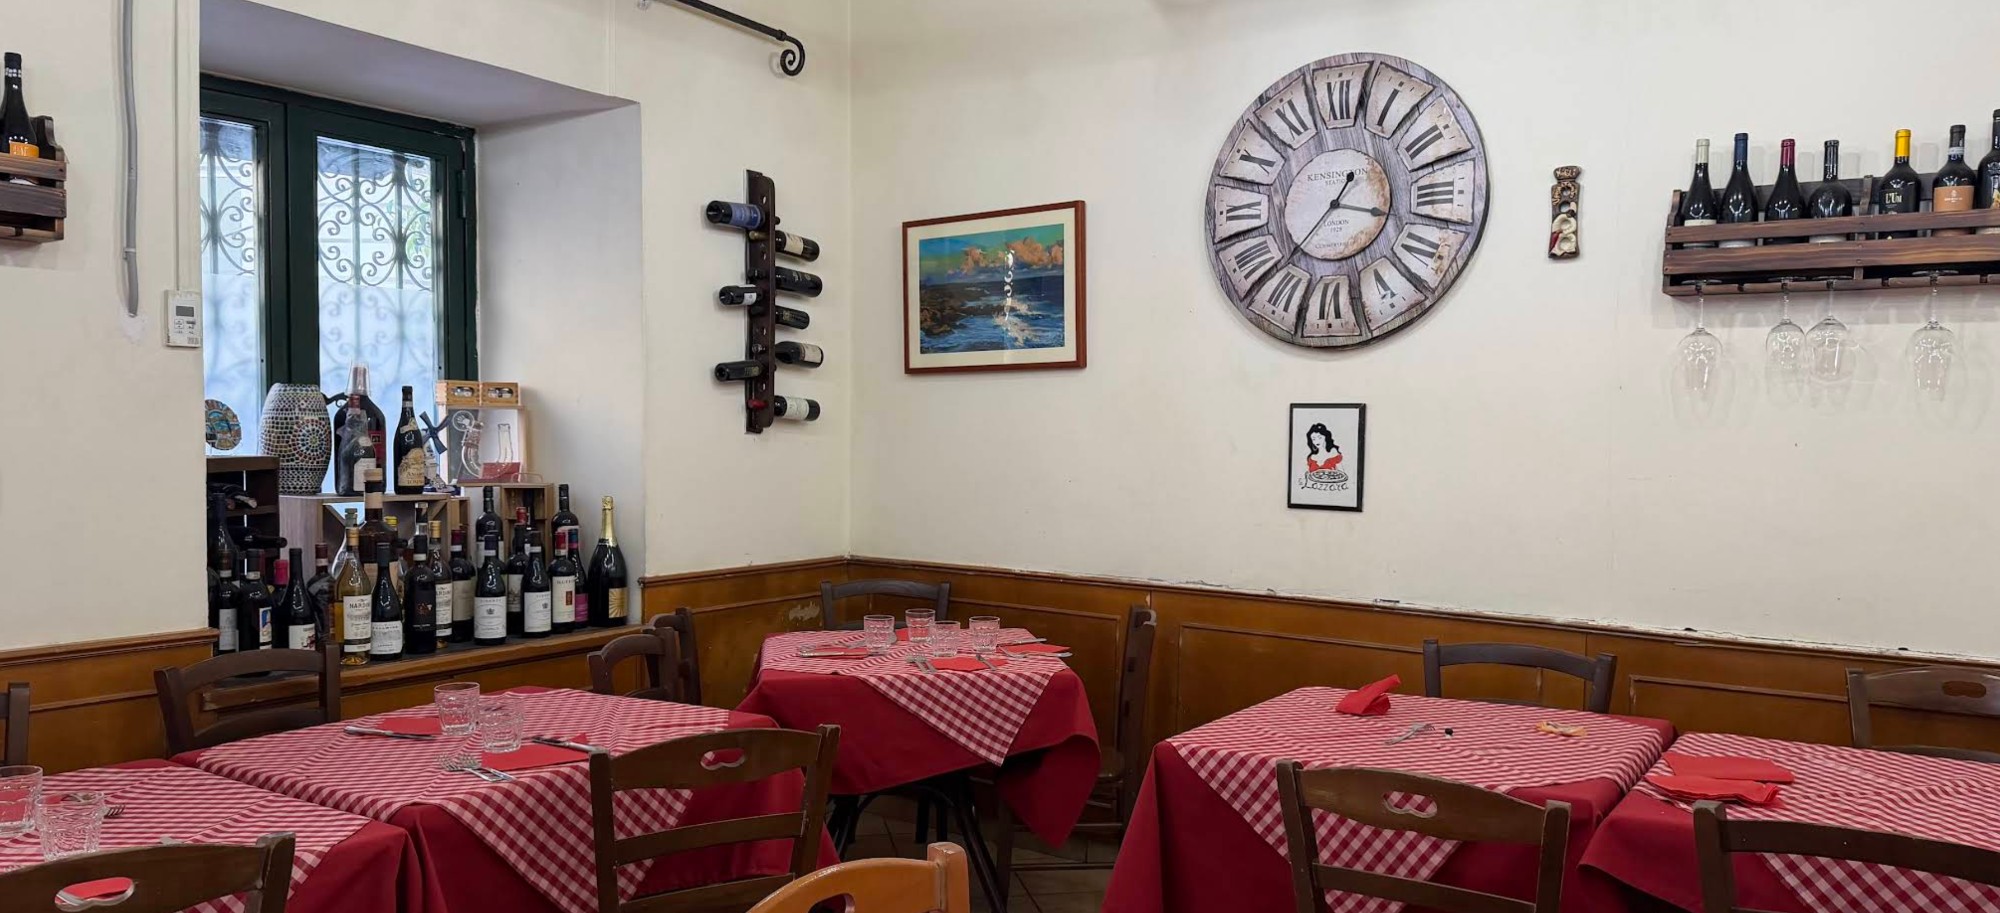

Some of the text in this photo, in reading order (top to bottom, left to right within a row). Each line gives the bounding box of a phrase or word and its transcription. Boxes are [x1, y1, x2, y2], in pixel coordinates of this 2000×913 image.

[1326, 80, 1351, 121] XII
[1377, 88, 1400, 126] I
[1275, 99, 1310, 143] XI
[1405, 124, 1444, 160] II
[1239, 149, 1276, 175] X
[1226, 201, 1262, 221] IX
[1416, 181, 1454, 207] III
[1323, 219, 1349, 227] LONDON
[1234, 240, 1275, 280] VIII
[1267, 271, 1302, 313] VII
[1318, 282, 1342, 320] VI
[1373, 268, 1398, 300] V
